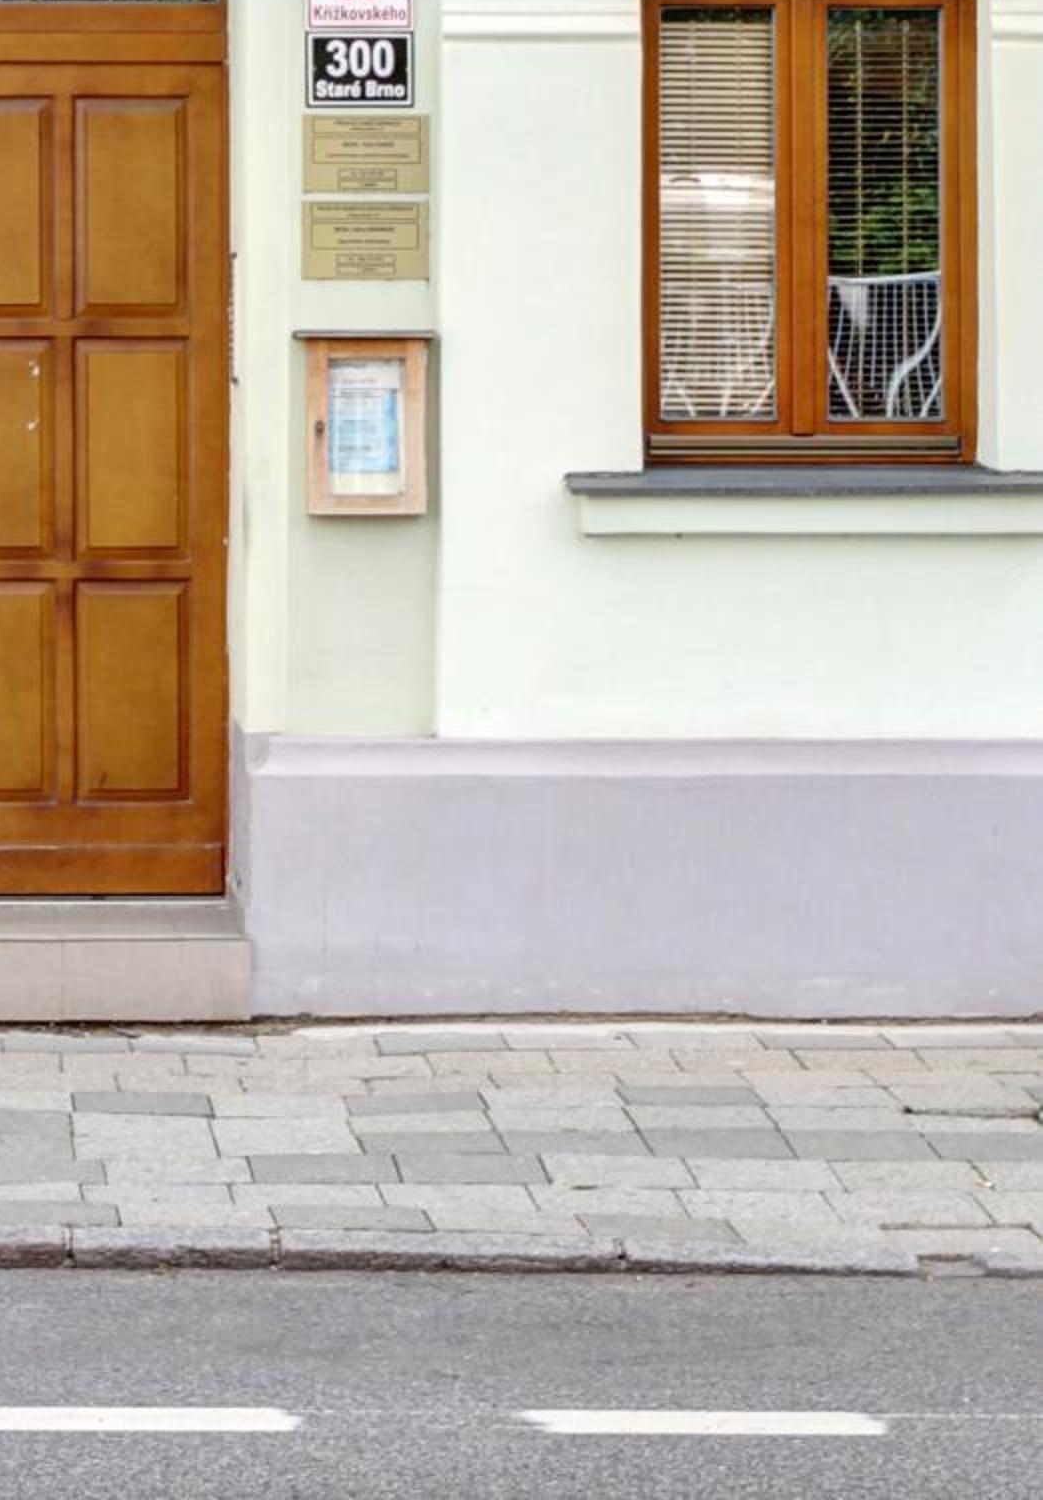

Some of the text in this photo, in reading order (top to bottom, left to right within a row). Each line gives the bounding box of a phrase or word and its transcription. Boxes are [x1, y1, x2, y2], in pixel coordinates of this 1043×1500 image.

[325, 39, 395, 78] 300
[315, 79, 406, 99] Staré Brno
